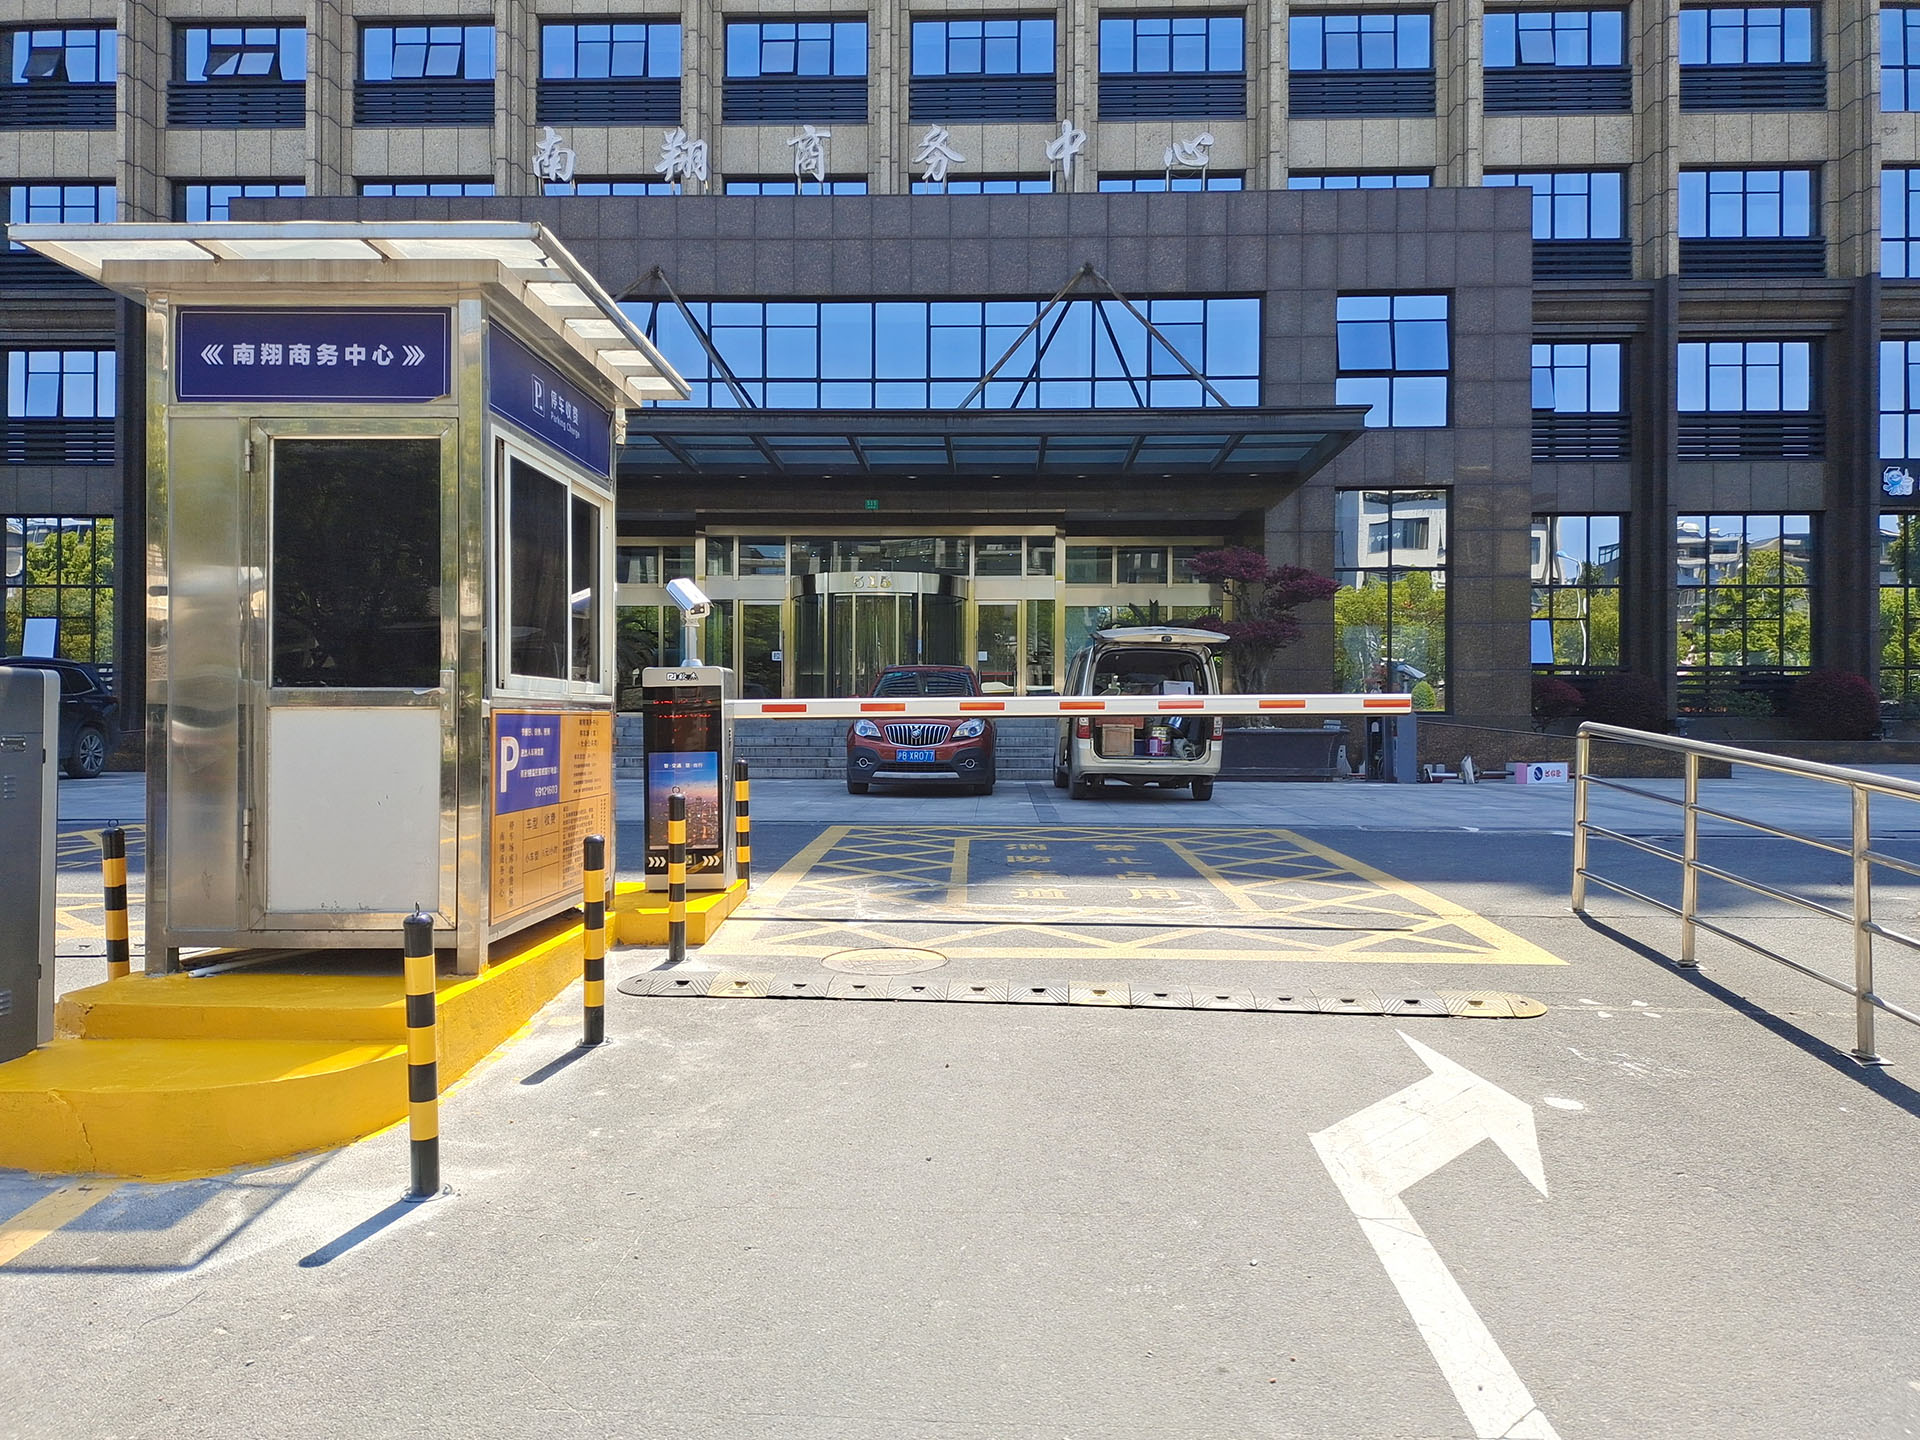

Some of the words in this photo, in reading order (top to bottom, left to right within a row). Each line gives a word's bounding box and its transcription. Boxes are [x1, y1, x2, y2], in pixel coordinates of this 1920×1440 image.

[532, 118, 1214, 183] 南翔商务中心
[232, 343, 394, 366] 南翔商务中心
[501, 736, 519, 793] P
